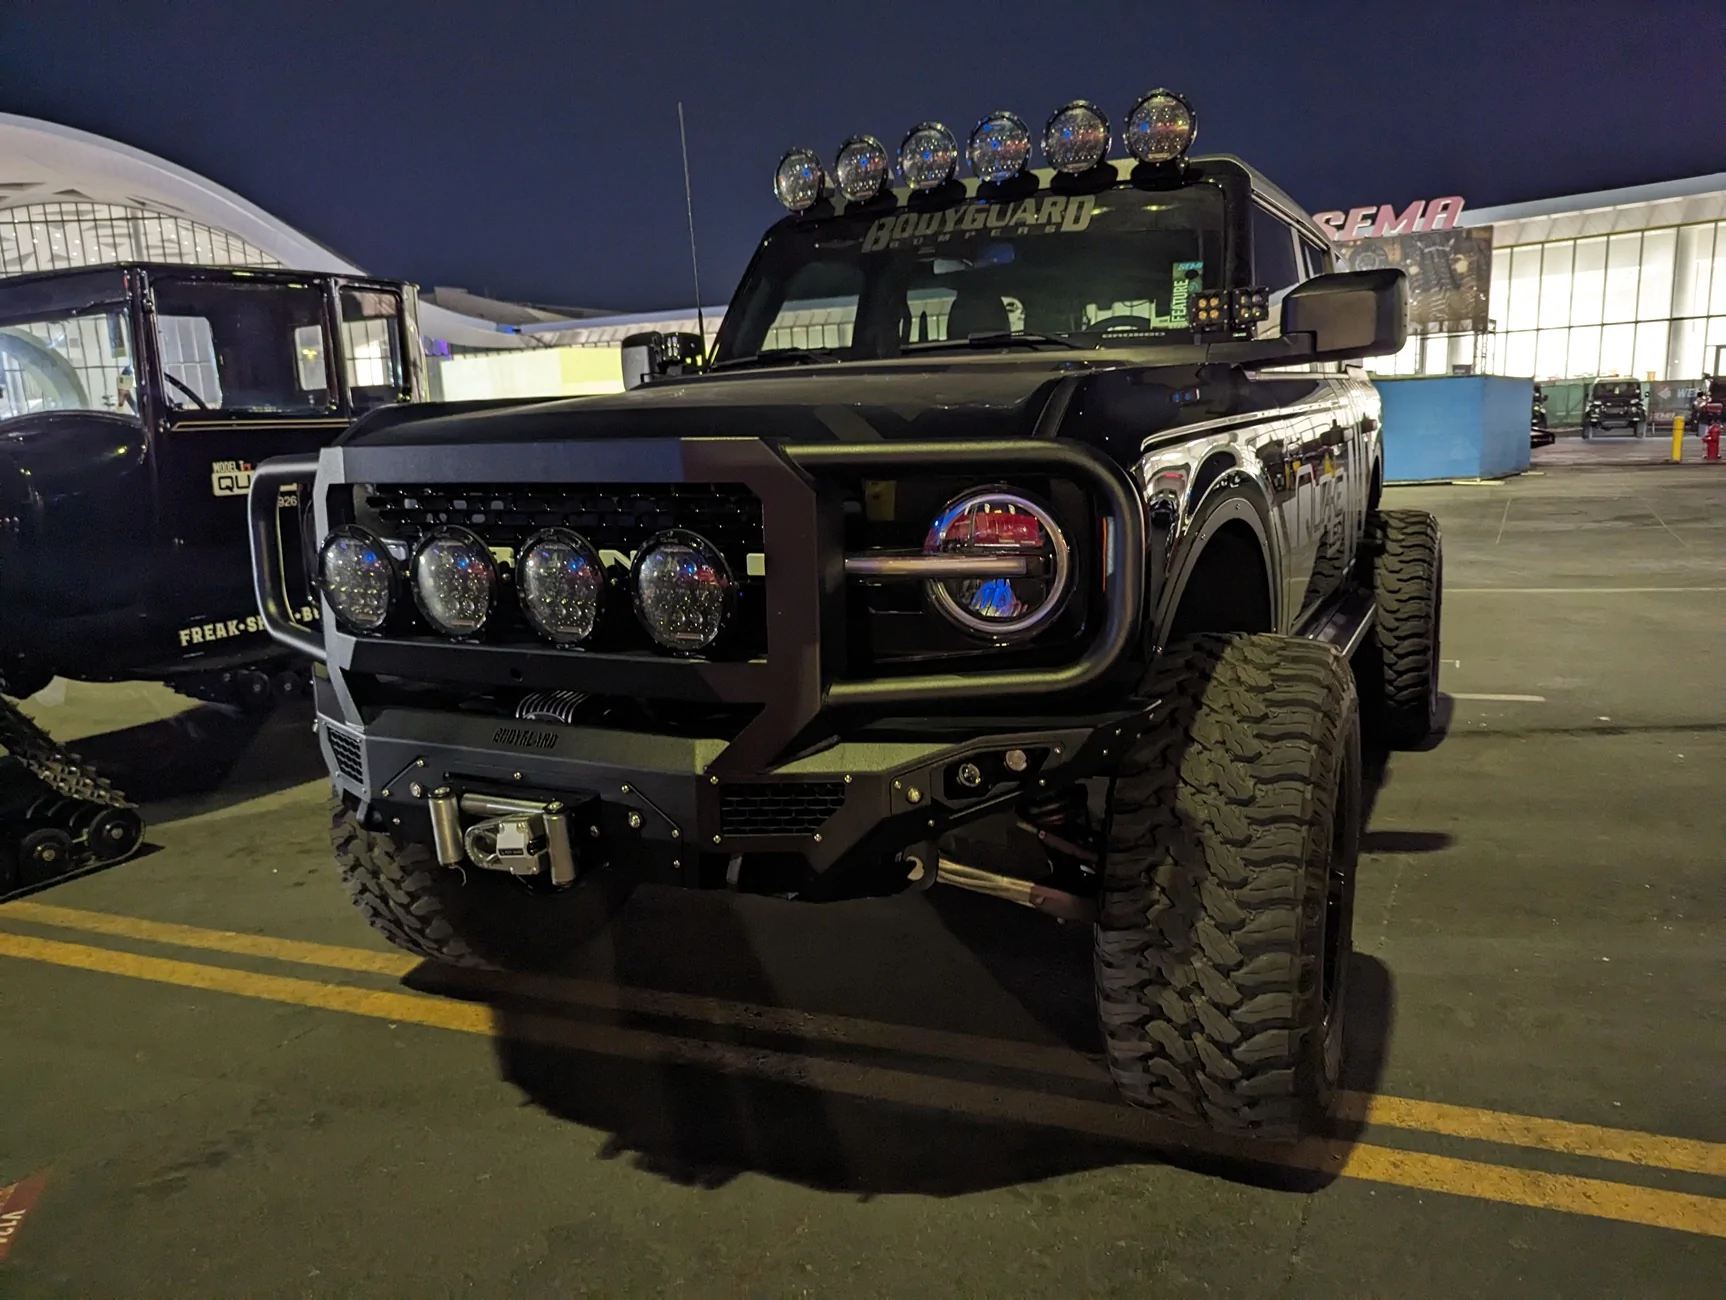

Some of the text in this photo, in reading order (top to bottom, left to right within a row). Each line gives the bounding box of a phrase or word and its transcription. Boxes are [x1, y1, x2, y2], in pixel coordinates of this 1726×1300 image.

[862, 195, 1095, 253] BODYGUARD
[1312, 196, 1465, 241] SEMA
[1172, 279, 1189, 322] FEATURE
[213, 461, 237, 473] MODEL
[179, 622, 239, 646] FREAK
